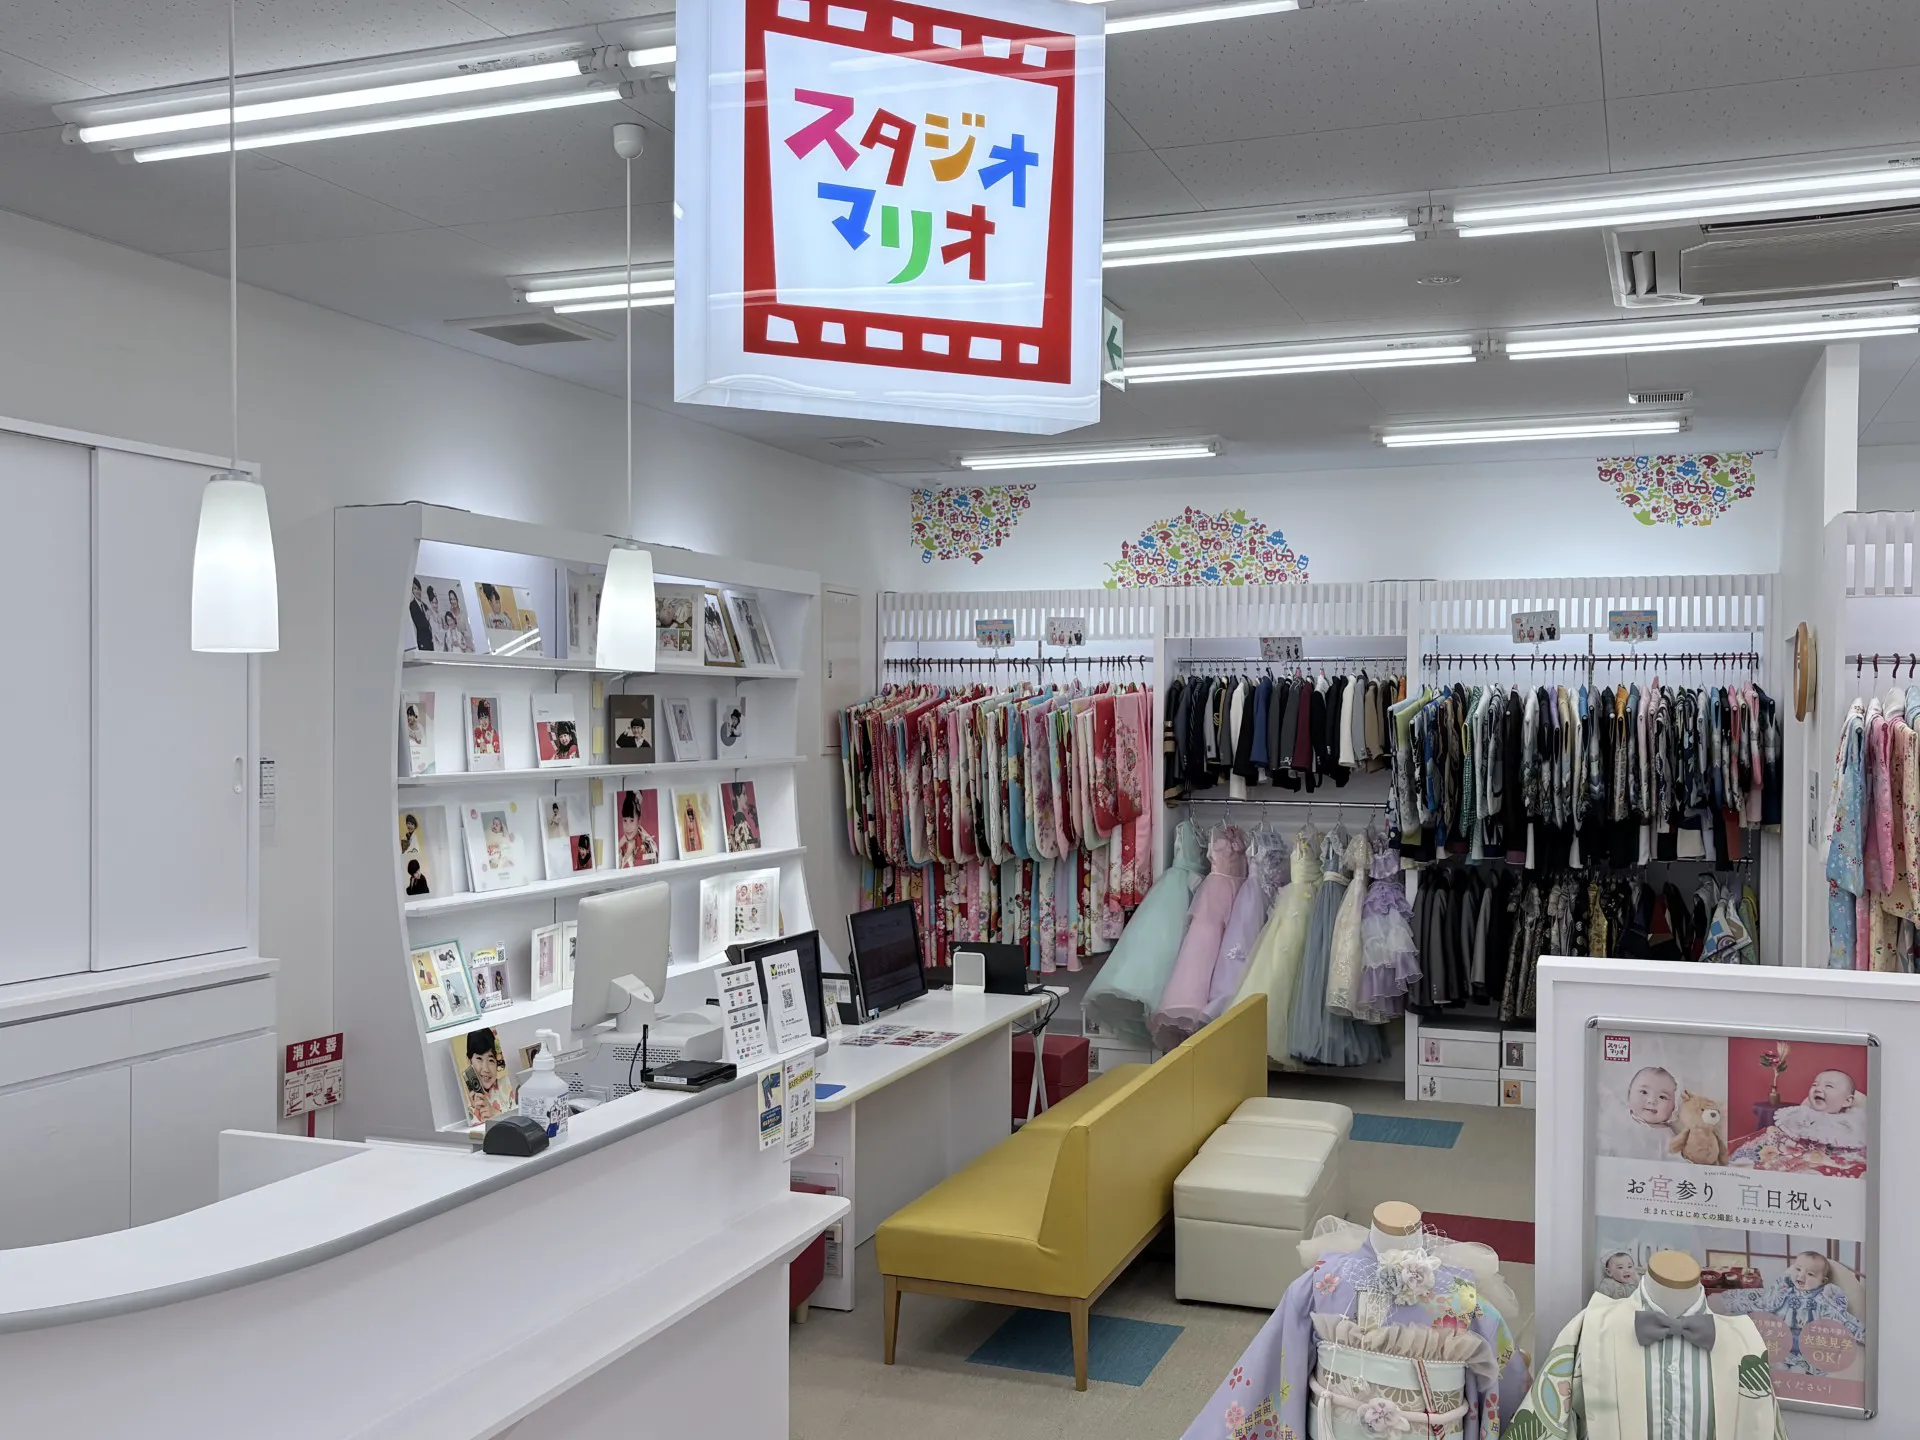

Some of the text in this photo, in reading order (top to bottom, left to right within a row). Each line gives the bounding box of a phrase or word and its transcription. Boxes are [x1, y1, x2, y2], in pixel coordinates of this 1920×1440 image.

[784, 88, 1039, 208] スタジオ
[817, 182, 996, 284] マリオ
[292, 1036, 337, 1061] 消火器
[1627, 1174, 1832, 1211] お宮参り 百日祝い
[1643, 1207, 1813, 1230] 生まれてはじめての撮影もおまかせください!
[1812, 1350, 1842, 1367] OK!
